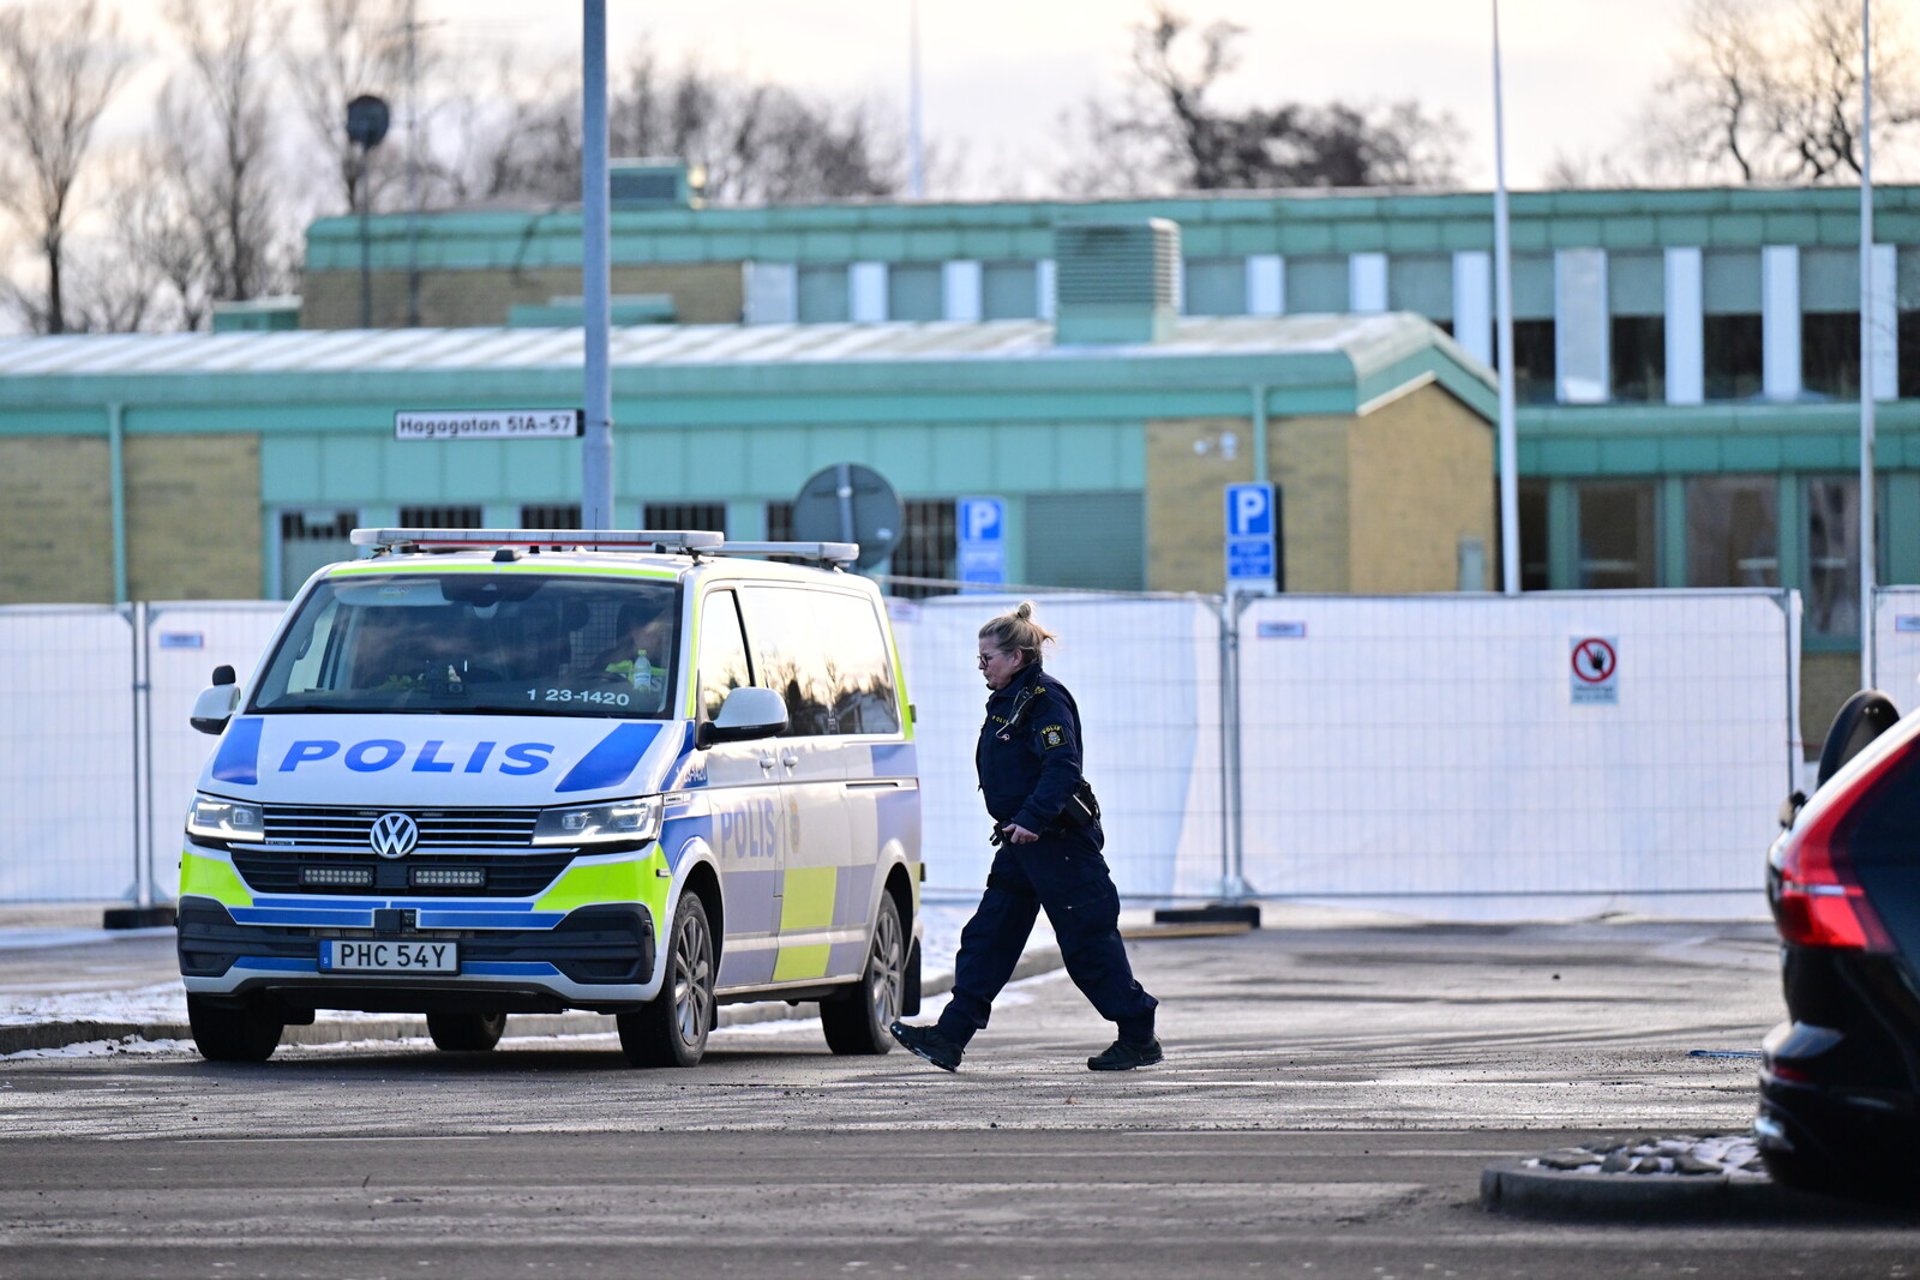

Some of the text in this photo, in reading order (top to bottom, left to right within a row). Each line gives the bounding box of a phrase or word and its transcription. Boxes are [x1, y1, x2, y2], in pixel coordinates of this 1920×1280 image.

[1237, 491, 1265, 533] P
[527, 689, 630, 707] 1 23-1420
[278, 739, 556, 776] POLIS
[720, 797, 776, 859] POLIS
[340, 943, 447, 968] PHC 54Y
